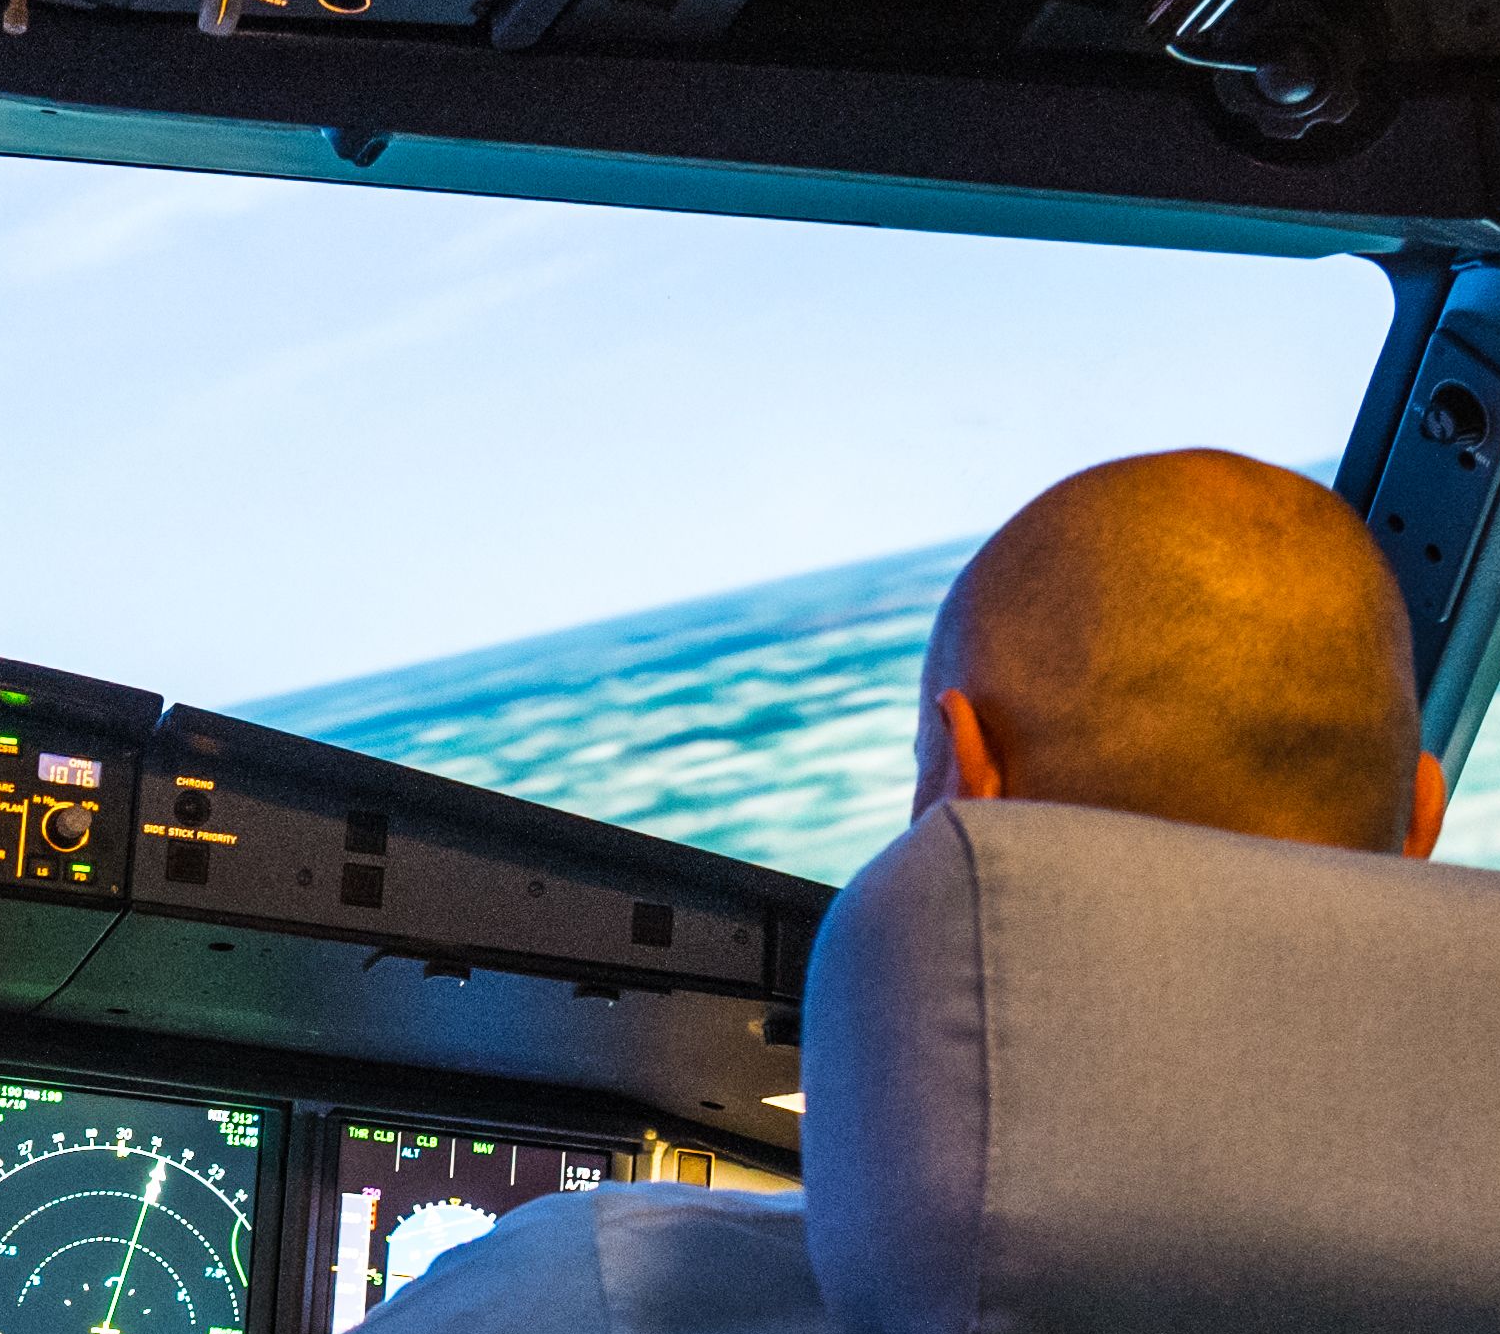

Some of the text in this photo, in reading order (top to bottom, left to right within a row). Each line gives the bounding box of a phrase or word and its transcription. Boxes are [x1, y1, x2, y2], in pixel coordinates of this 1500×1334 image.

[177, 777, 214, 790] CHRONO
[1, 803, 23, 813] PLAN
[144, 825, 237, 844] SIDE STICK PRIORITY
[117, 1127, 132, 1139] 30
[349, 1126, 394, 1142] THR CLB
[18, 1139, 33, 1155] 27
[417, 1136, 437, 1147] CLB
[402, 1148, 420, 1158] ALT
[473, 1142, 494, 1154] NAV
[567, 1167, 600, 1180] 1 FD 2
[362, 1187, 381, 1198] 250
